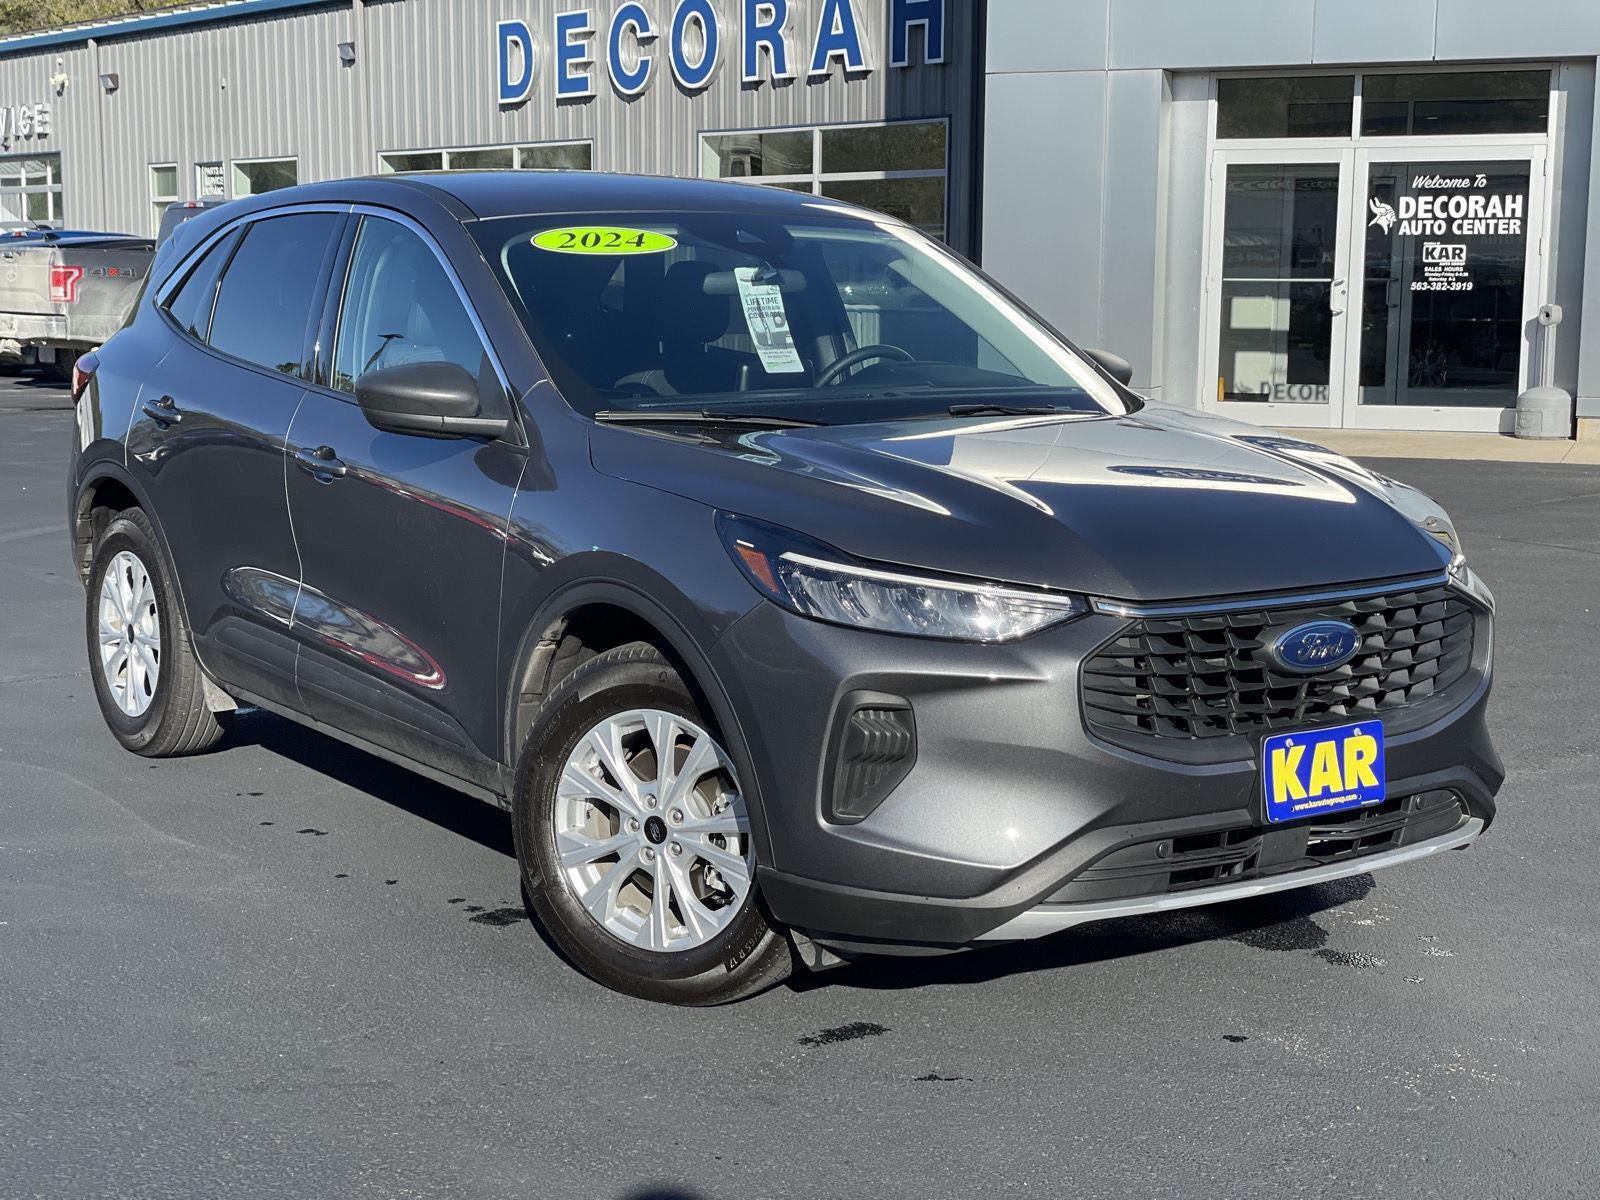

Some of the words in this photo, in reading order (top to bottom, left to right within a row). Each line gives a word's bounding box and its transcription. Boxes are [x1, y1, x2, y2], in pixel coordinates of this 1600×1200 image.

[496, 0, 946, 104] DECORAH
[1412, 175, 1470, 189] Welcome
[1473, 174, 1487, 188] To
[1398, 195, 1523, 219] DECORAH
[1398, 220, 1446, 236] AUTO
[1452, 219, 1521, 235] CENTER
[557, 232, 646, 249] 2024
[1424, 246, 1465, 260] KAR
[1410, 281, 1473, 291] 563-382-3919
[745, 297, 780, 306] LIFETIME
[1298, 633, 1344, 659] Ford
[1271, 734, 1380, 804] KAR
